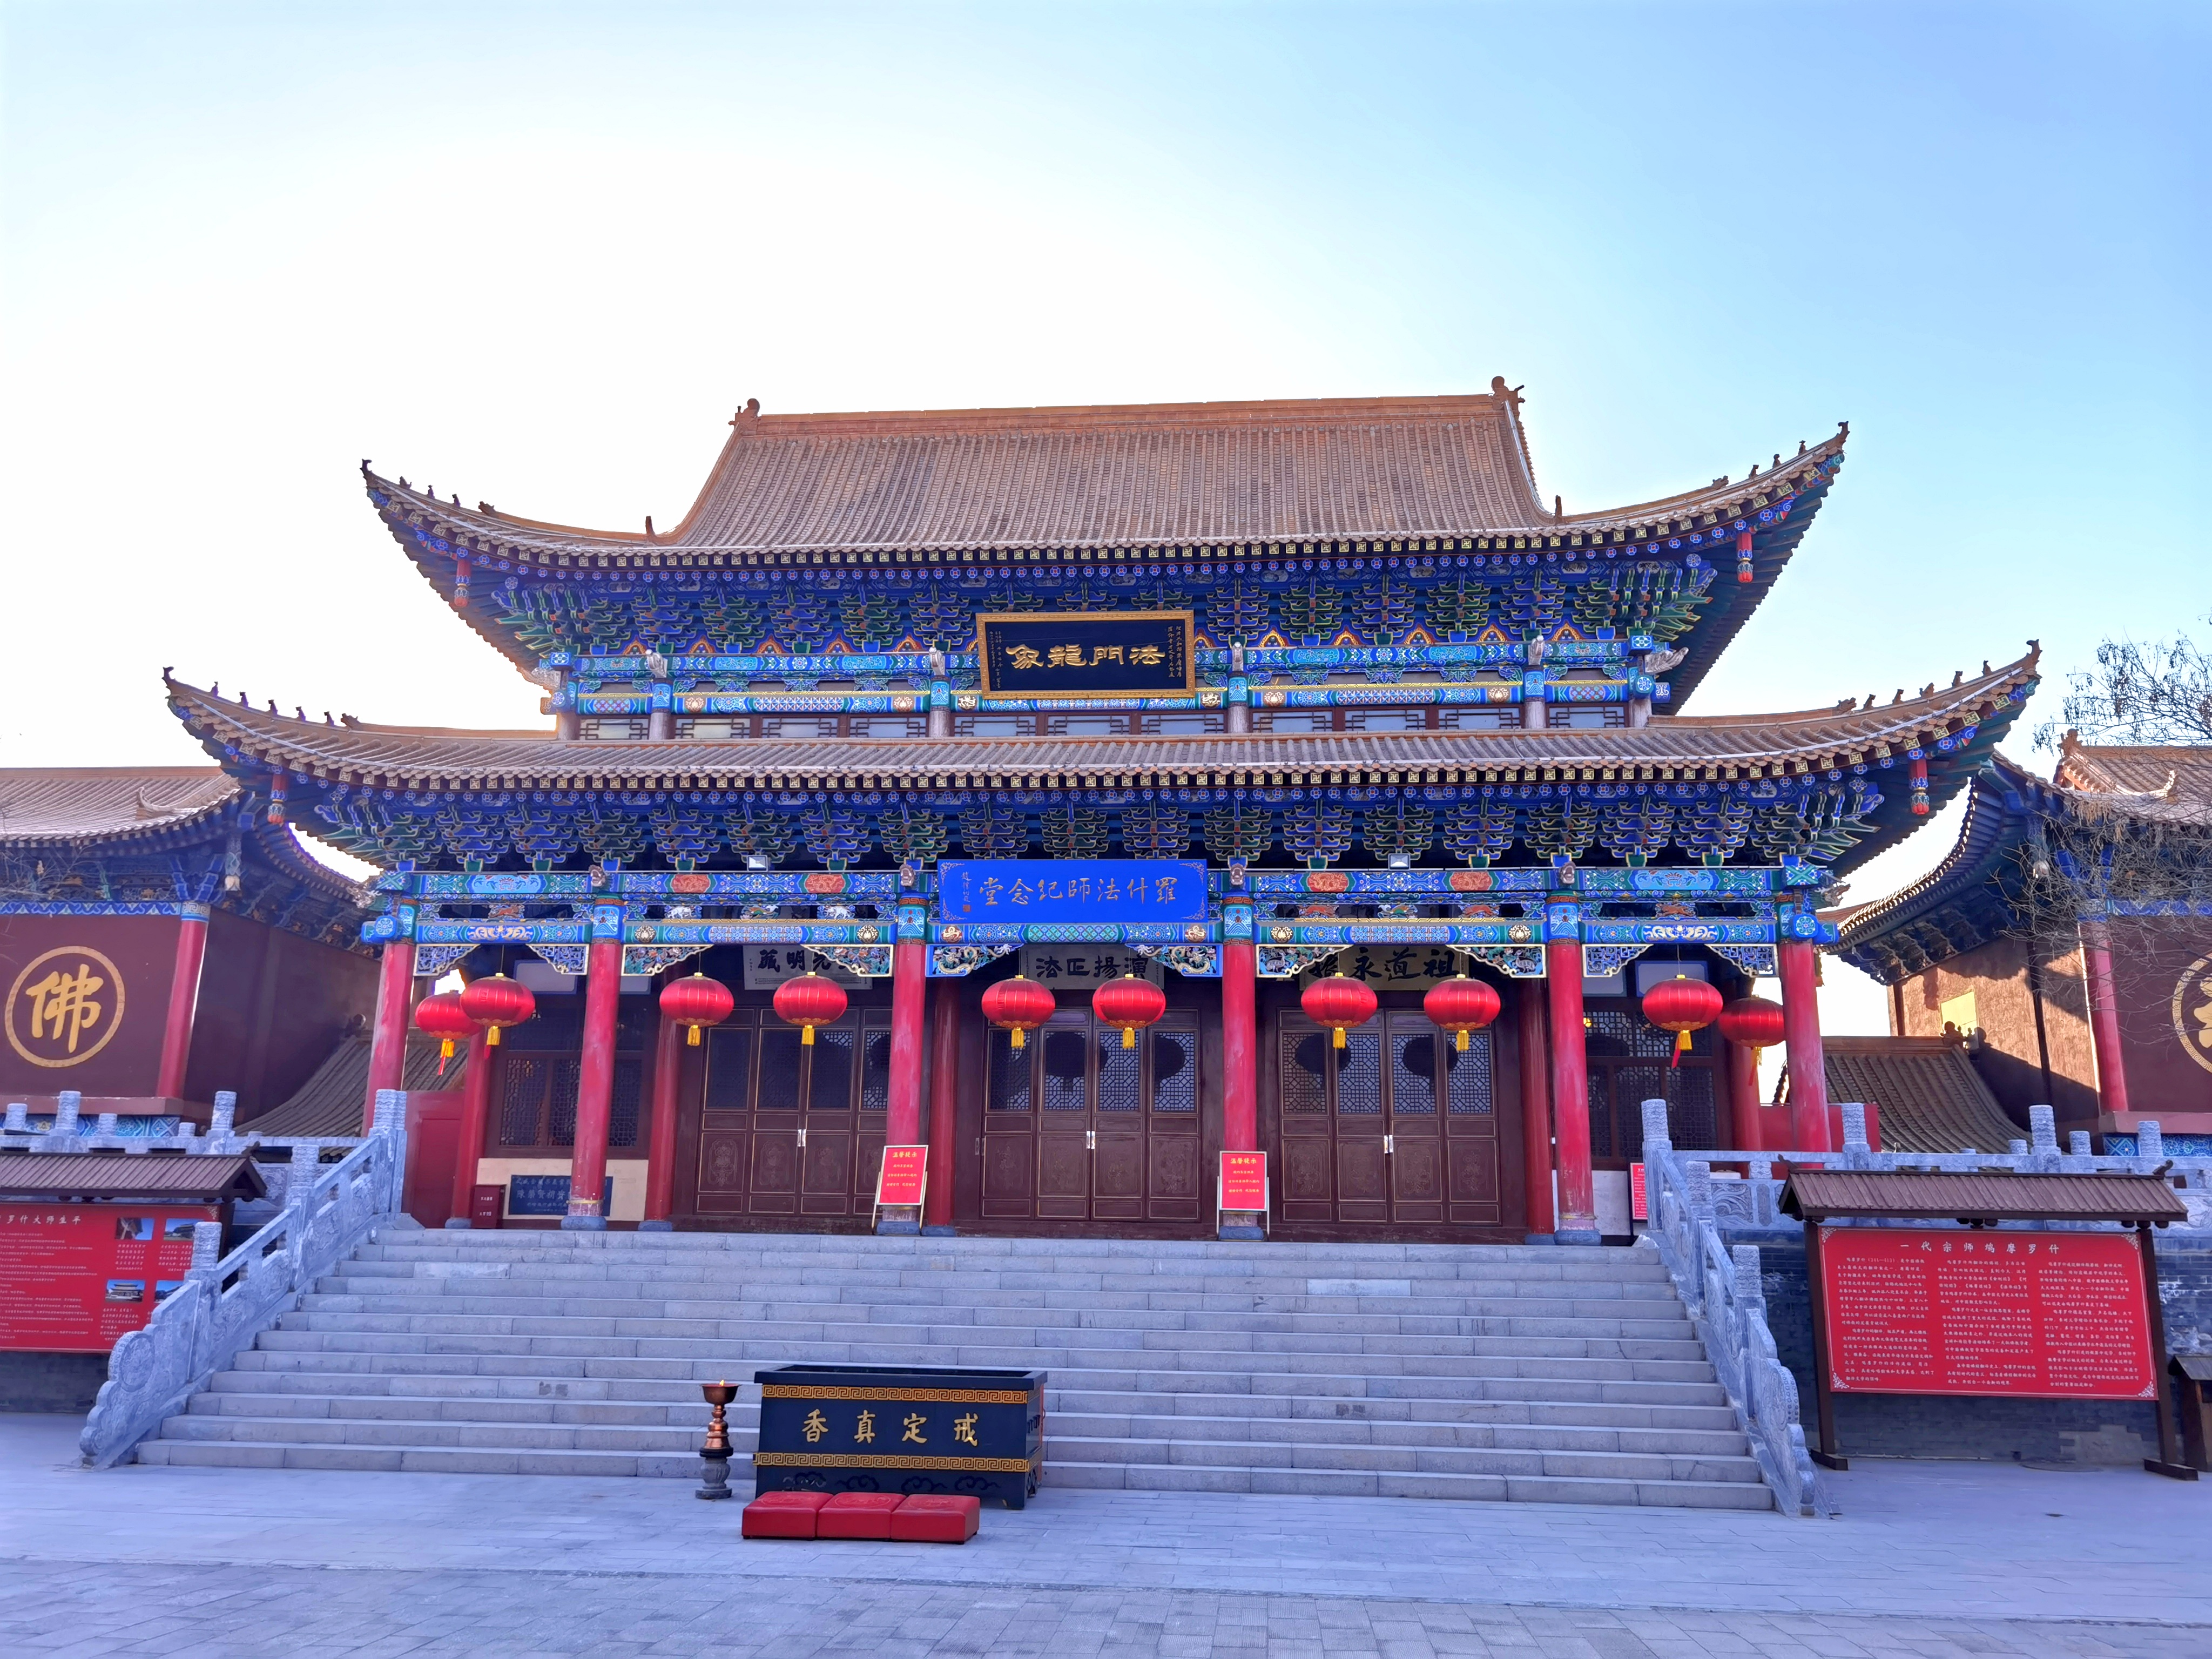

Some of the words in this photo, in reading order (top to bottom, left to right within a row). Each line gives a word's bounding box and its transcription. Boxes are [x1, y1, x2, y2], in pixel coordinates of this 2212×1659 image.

[979, 877, 1178, 906] 羅什法師紀念堂
[25, 963, 104, 1053] 佛
[0, 1215, 81, 1225] 罗什大师生平
[1900, 1241, 2059, 1255] 一代宗师鸠摩罗什
[801, 1409, 980, 1446] 戒定真香
